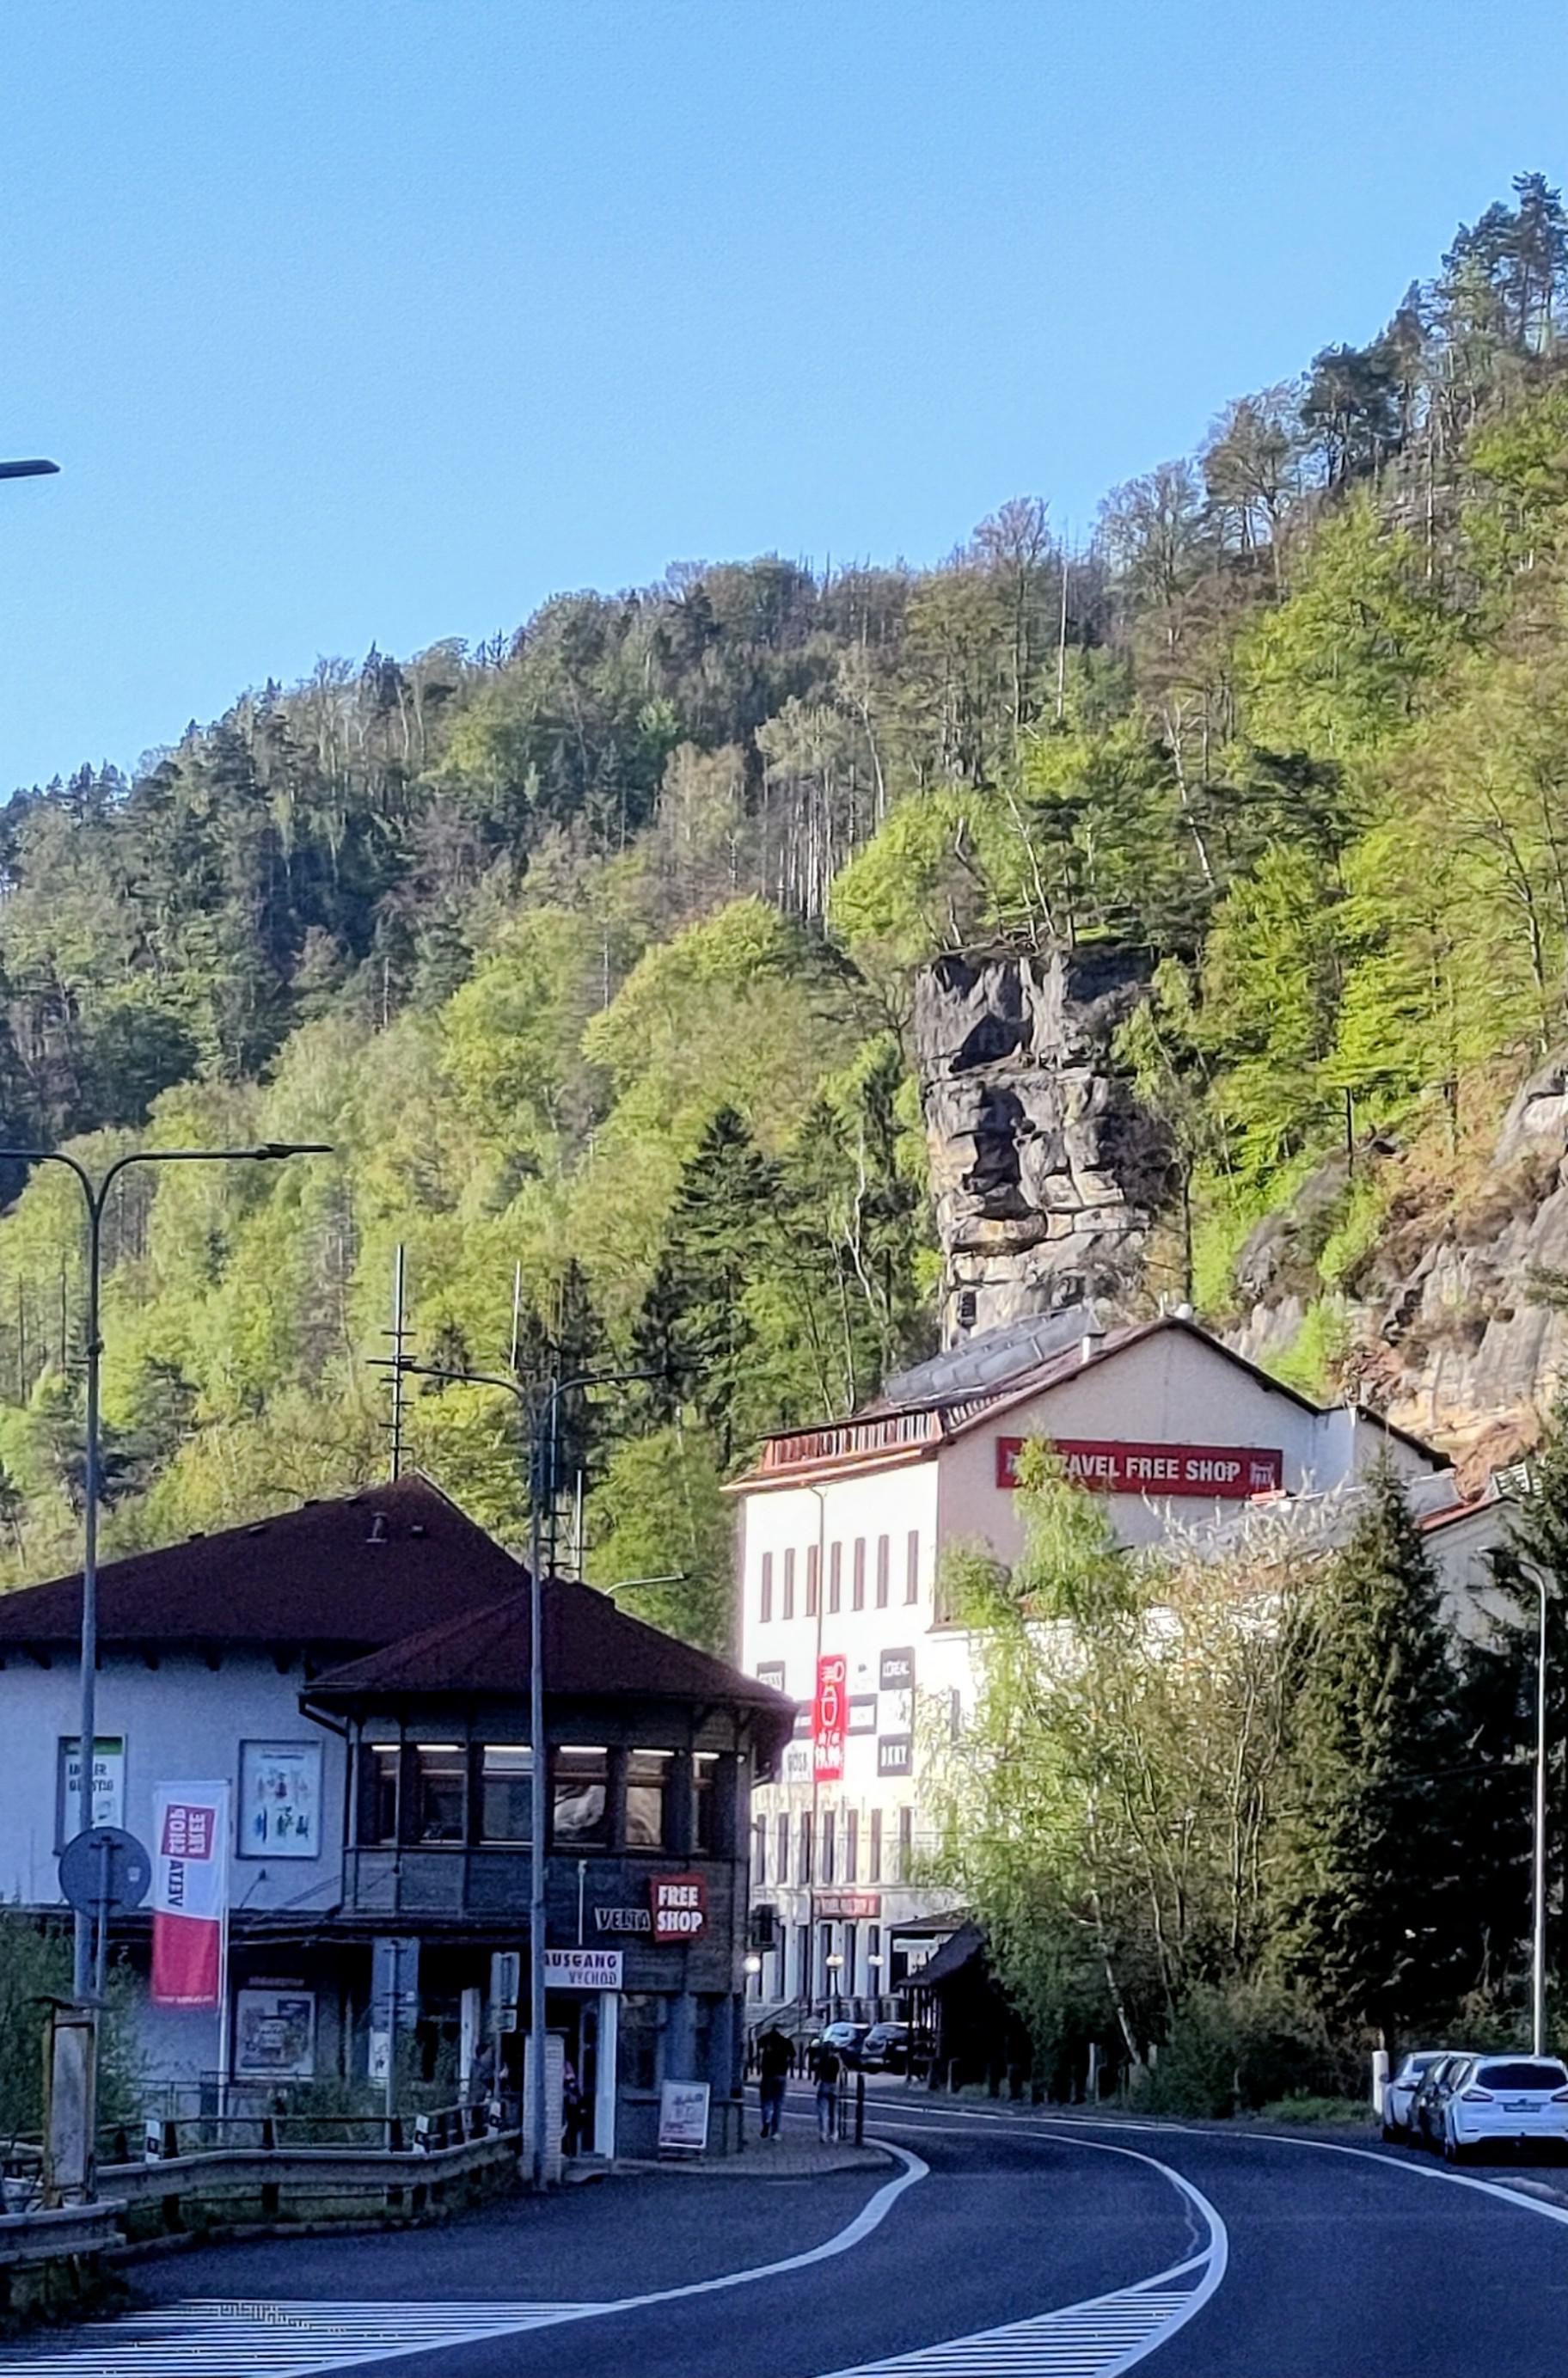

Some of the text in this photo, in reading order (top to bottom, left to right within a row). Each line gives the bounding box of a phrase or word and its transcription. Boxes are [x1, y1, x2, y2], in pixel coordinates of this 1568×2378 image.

[1125, 1456, 1179, 1480] FREE
[1185, 1459, 1241, 1483] SHOP
[658, 1885, 699, 1908] FREE
[595, 1908, 703, 1933] VELTA SHOP
[544, 1952, 617, 1969] AUSGANG
